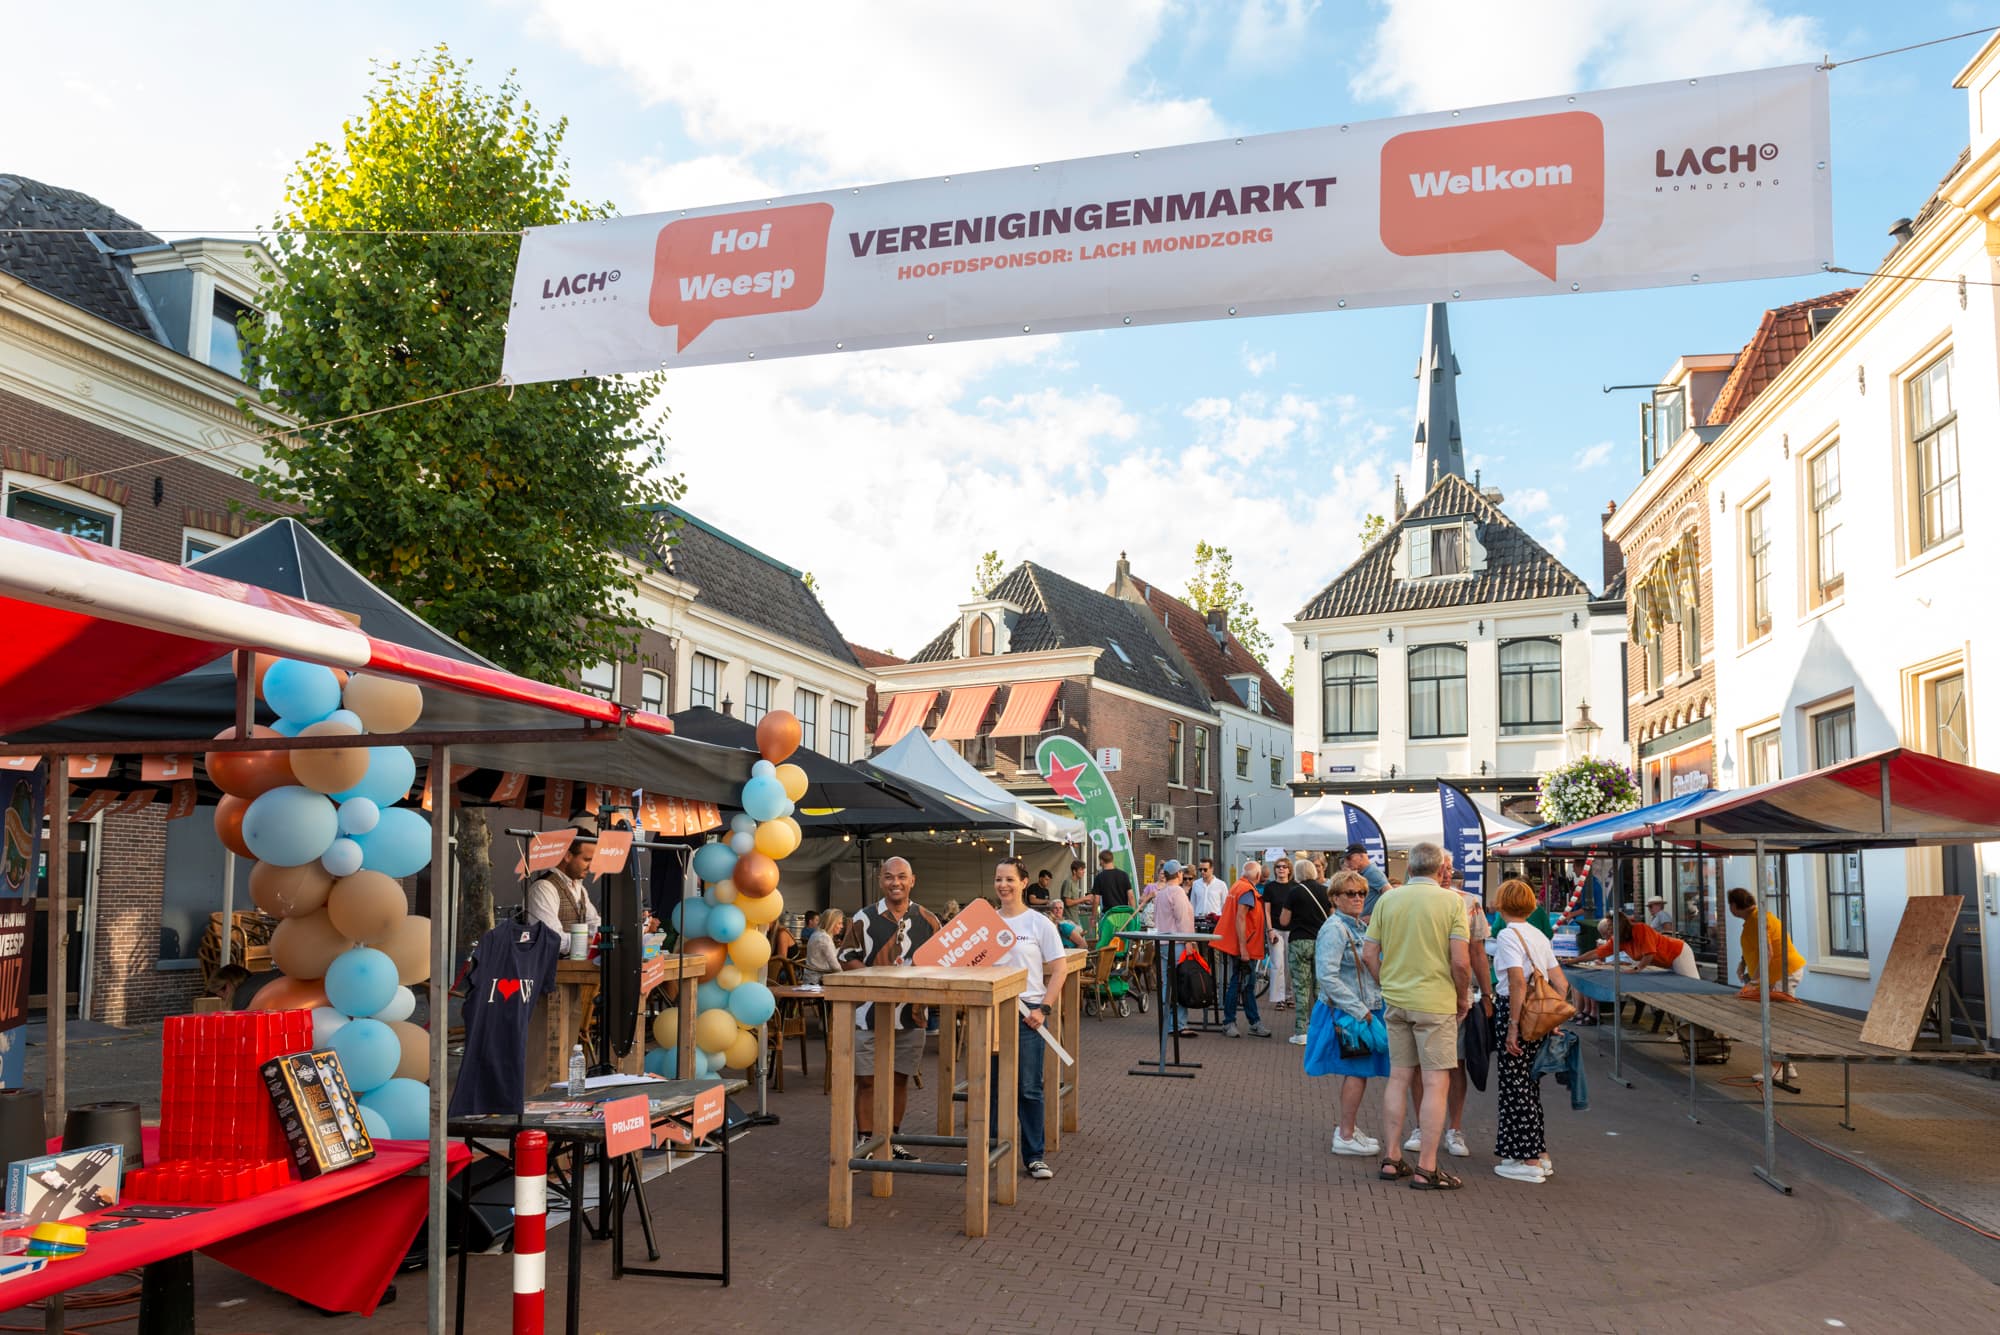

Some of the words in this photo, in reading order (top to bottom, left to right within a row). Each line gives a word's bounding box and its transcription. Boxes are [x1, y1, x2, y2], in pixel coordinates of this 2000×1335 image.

[1655, 143, 1757, 178] LACH
[1409, 161, 1573, 198] Welkom
[1655, 178, 1780, 193] MONDZORG
[848, 176, 1337, 259] VERENIGINGENMARKT
[710, 223, 773, 255] Hoi
[897, 249, 1073, 281] HOOFDSPONSOR:
[1079, 240, 1136, 262] LACH
[1142, 227, 1274, 255] MONDZORG
[542, 270, 608, 299] LACH
[679, 268, 796, 302] Weesp
[937, 926, 990, 967] Weesp
[939, 920, 968, 948] Hoi
[487, 978, 498, 1003] I
[612, 1115, 645, 1135] PRIJZEN
